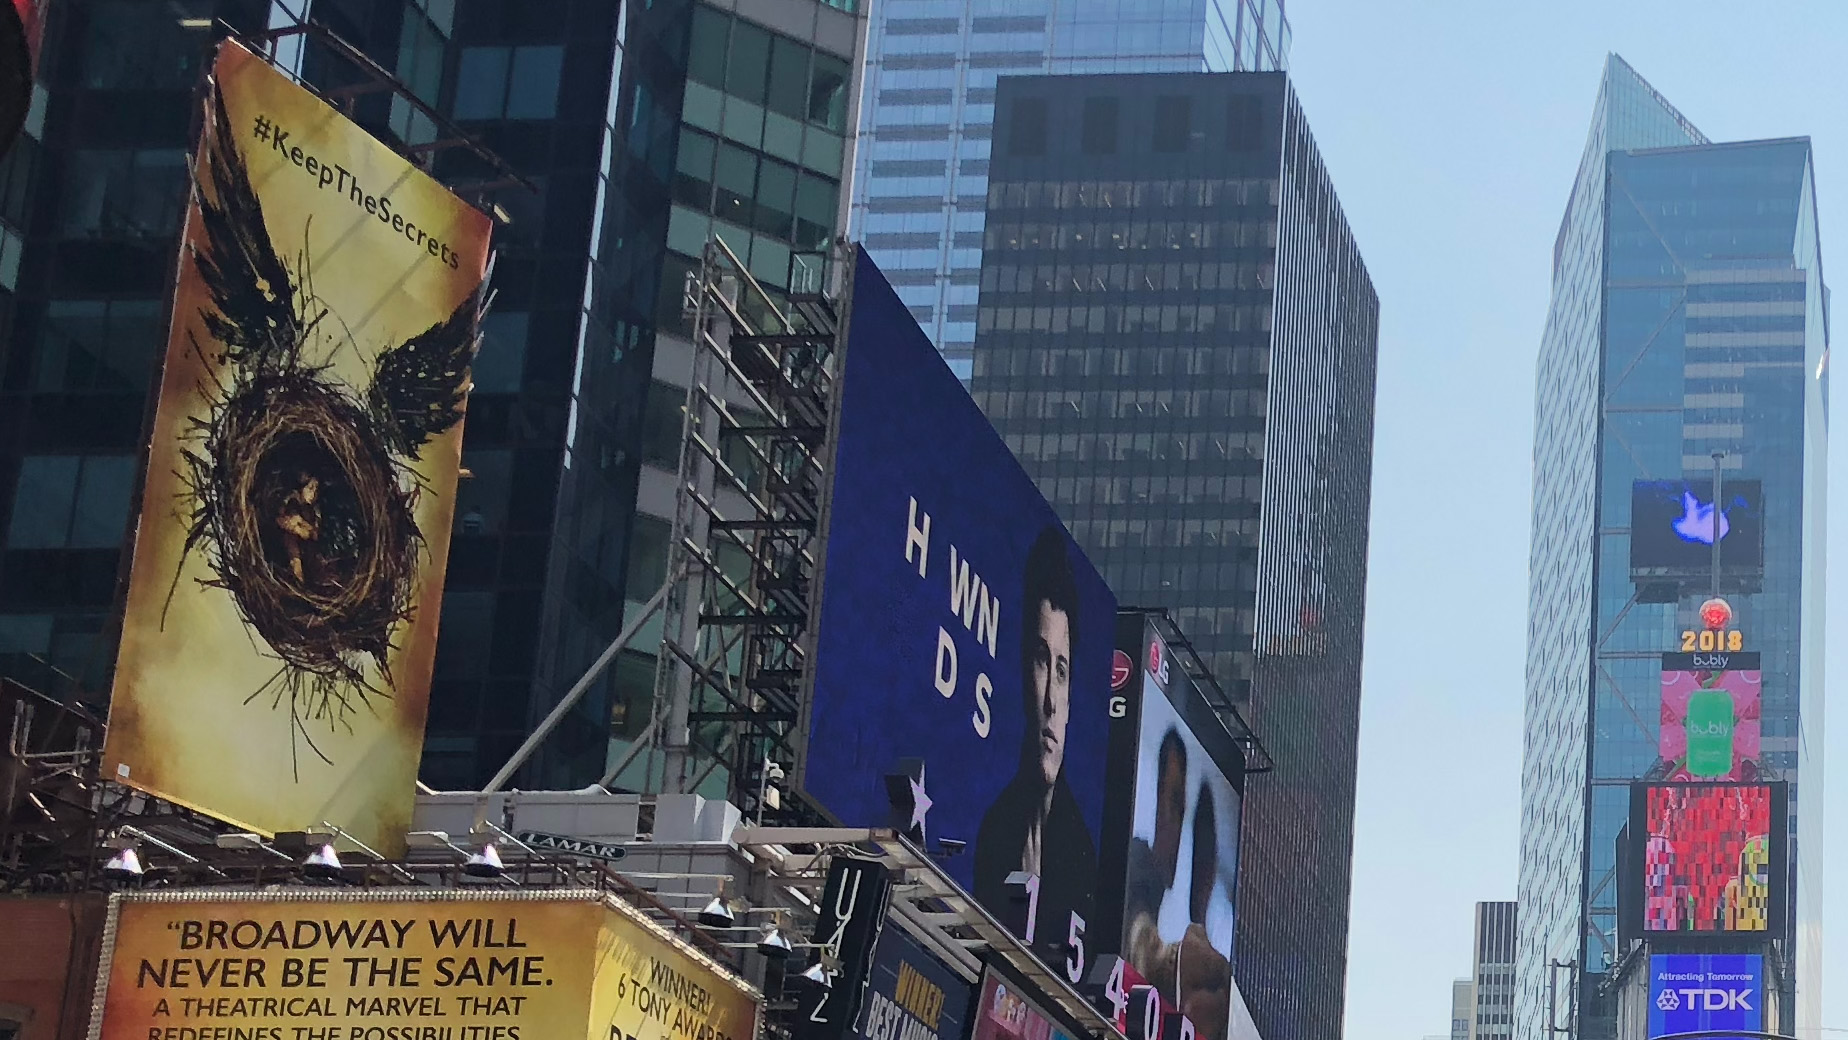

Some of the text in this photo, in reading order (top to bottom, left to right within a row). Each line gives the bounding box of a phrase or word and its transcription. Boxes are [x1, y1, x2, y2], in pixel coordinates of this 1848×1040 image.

[253, 114, 461, 271] #KeepTheSecrets
[1682, 631, 1742, 652] 2018
[1159, 653, 1170, 685] LG
[527, 834, 616, 857] LAMAR
[431, 918, 528, 949] WILL
[137, 956, 555, 989] NEVER BE THE SAME.
[650, 956, 714, 1017] WINNER!
[1657, 972, 1754, 983] Attracting Tomorrow
[152, 996, 527, 1018] A THEATRICAL MARVEL THAT
[617, 972, 627, 1000] 6
[631, 978, 672, 1025] TONY
[1679, 988, 1754, 1011] TDK
